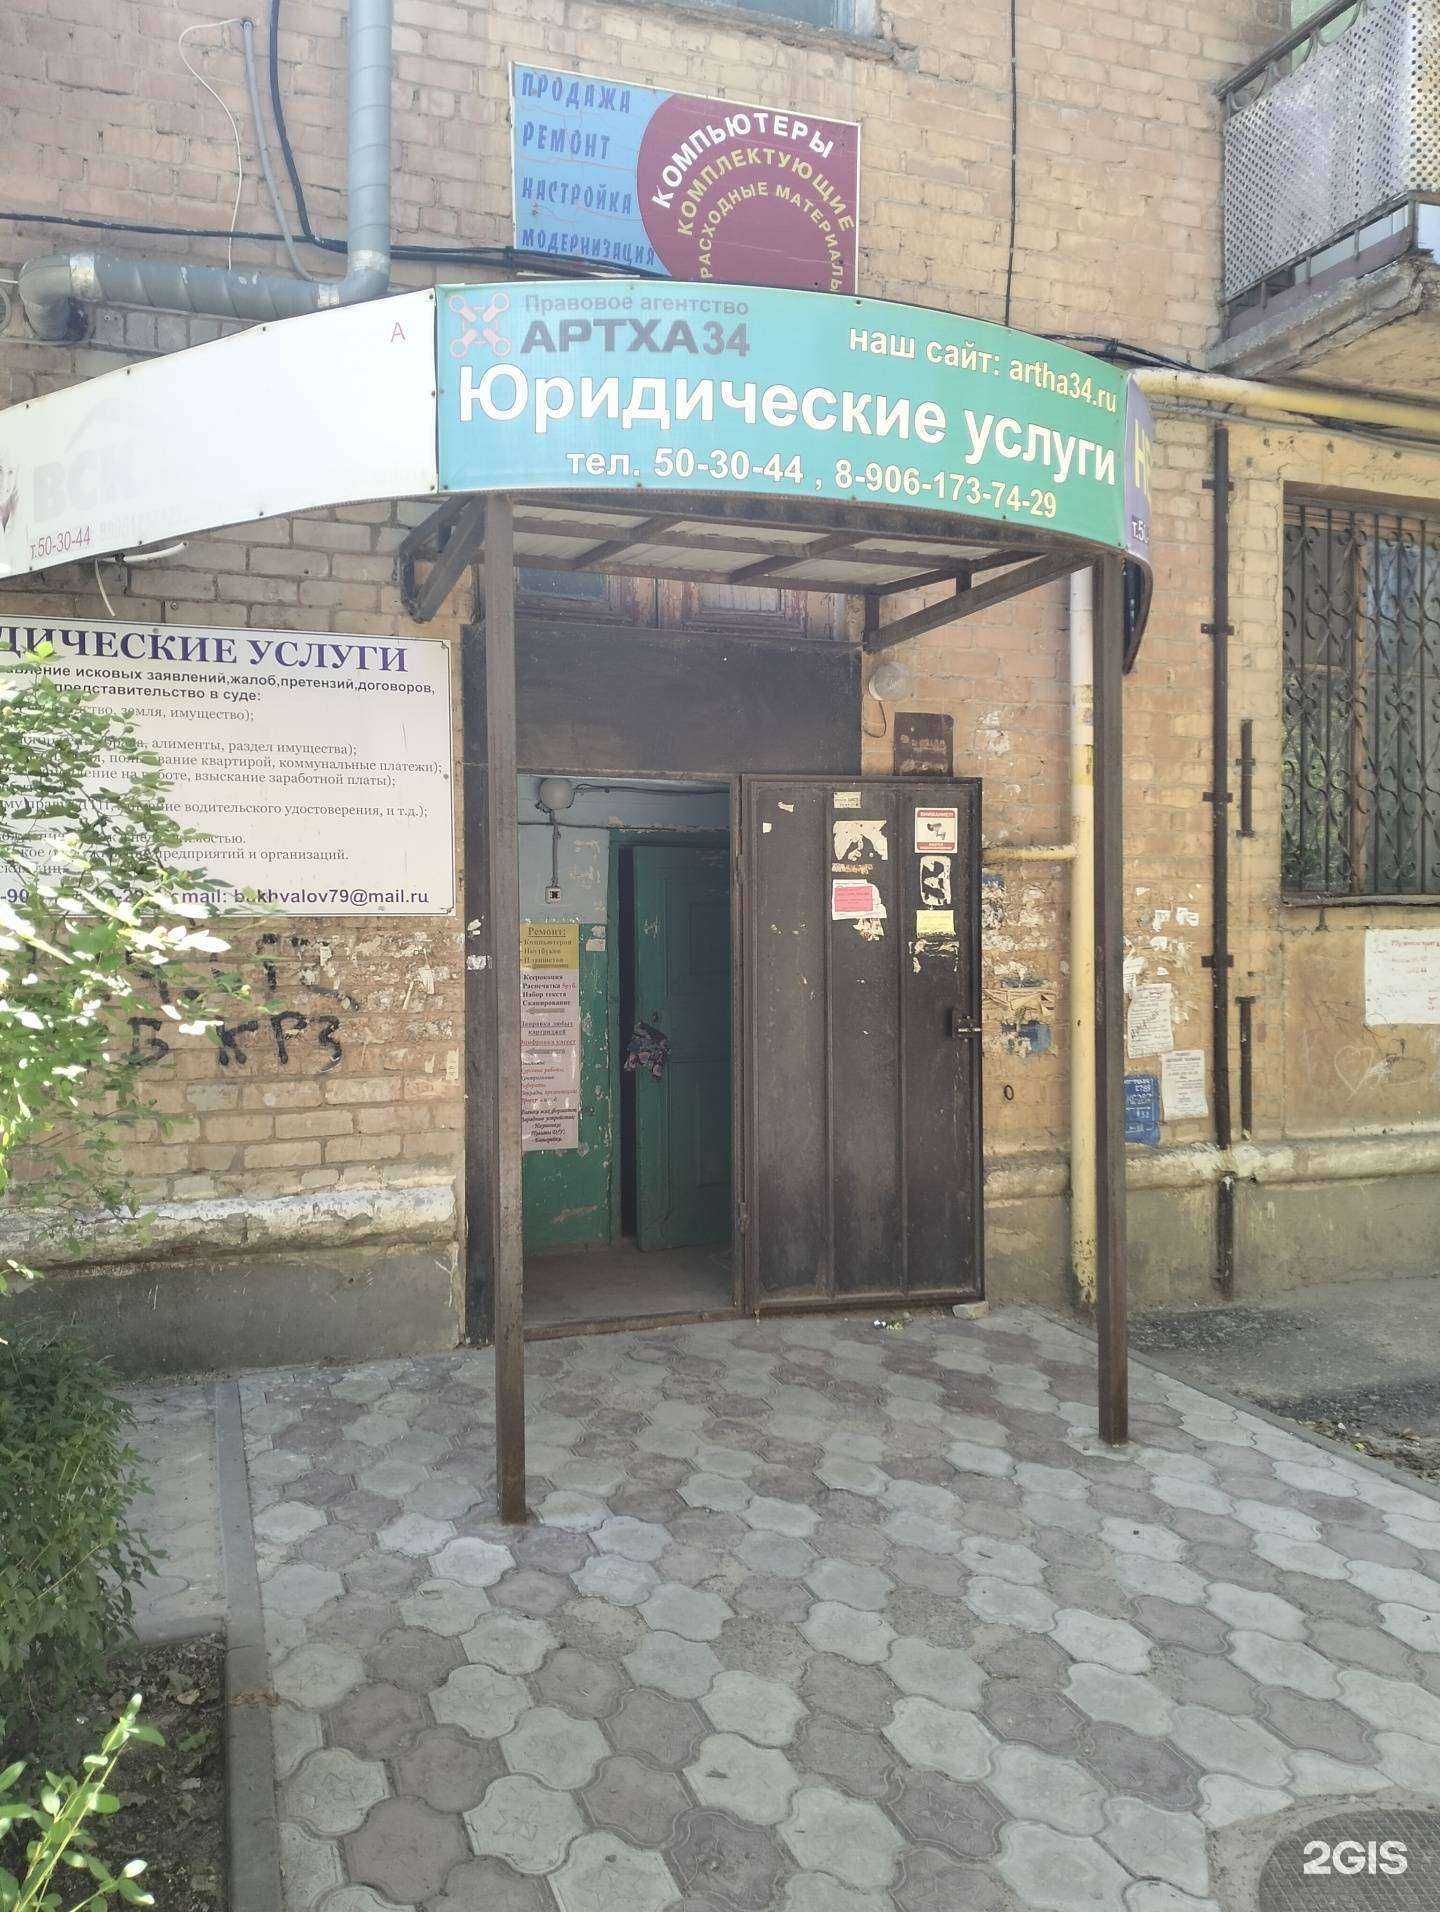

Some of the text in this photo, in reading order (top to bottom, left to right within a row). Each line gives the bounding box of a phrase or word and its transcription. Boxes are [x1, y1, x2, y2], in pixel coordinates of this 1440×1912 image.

[521, 72, 631, 114] ПРОДАЖА
[522, 120, 610, 160] РЕМОНТ
[651, 112, 835, 209] КОМПЬЮТЕРЫ
[522, 176, 632, 215] НАСТРОЙКА
[677, 147, 855, 236] КОМПЛЕКТУЮЩИЕ
[699, 181, 769, 279] РАСХОДНЫЕ
[522, 228, 655, 266] МОДЕРНИЗАЦИЯ
[525, 293, 749, 316] Правовое агентство
[391, 321, 406, 342] А
[520, 318, 750, 356] АРТХА34
[850, 327, 1117, 413] наш сайт: artha34.ru
[459, 363, 1116, 486] Юридические услуги
[566, 452, 640, 477] тел.
[654, 447, 804, 483] 50-30-44
[835, 459, 1057, 519] 8-906-173-74-29
[30, 526, 92, 559] т.50-30-44
[246, 639, 408, 673] УСЛУГИ
[76, 667, 142, 680] исковых
[210, 690, 218, 699] в
[224, 692, 261, 703] суде:
[170, 708, 255, 722] имущество);
[151, 738, 224, 752] алименты,
[228, 741, 273, 754] раздел
[277, 743, 357, 757] имущества);
[122, 770, 137, 780] на
[195, 771, 266, 782] взыскание
[269, 772, 343, 786] заработной
[347, 775, 396, 788] платы);
[201, 757, 276, 772] квартирой,
[279, 759, 376, 772] коммунальные
[380, 762, 442, 775] платежи);
[185, 800, 281, 814] водительского
[284, 804, 383, 818] удостоверения,
[250, 851, 257, 859] и
[260, 848, 349, 863] организаций.
[235, 888, 429, 906] bkhvalov79@mail.ru
